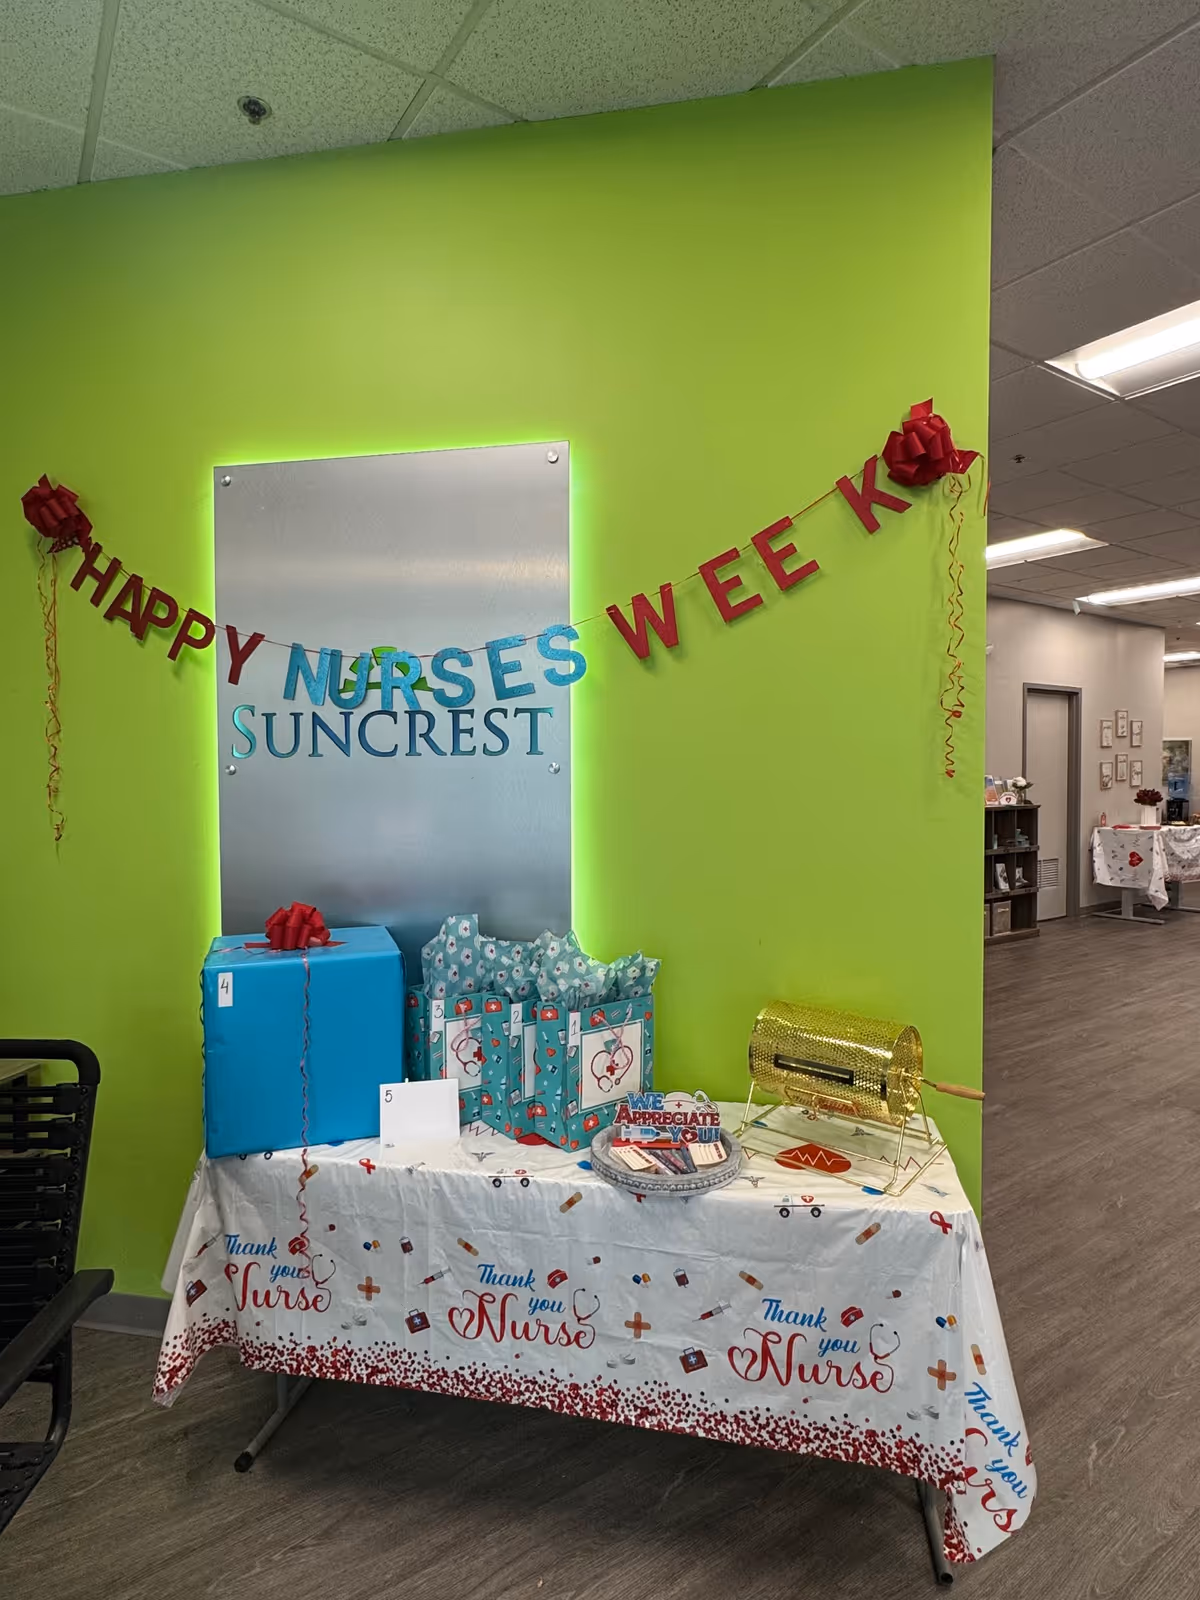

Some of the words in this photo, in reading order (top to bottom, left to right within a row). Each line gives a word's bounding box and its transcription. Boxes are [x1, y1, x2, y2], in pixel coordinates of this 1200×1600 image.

[70, 540, 265, 685] HAPPY
[283, 624, 587, 710] NURSES
[606, 455, 912, 660] WEEK
[231, 704, 554, 759] SUNCREST
[220, 978, 229, 995] 4
[434, 1004, 444, 1019] 3
[512, 1010, 522, 1024] 2
[570, 1019, 578, 1036] 1
[384, 1089, 393, 1103] 5
[627, 1092, 664, 1111] WE
[614, 1104, 720, 1126] APPRECIATE
[224, 1234, 277, 1259] Thank
[477, 1263, 536, 1291] Thank
[528, 1296, 566, 1316] you
[761, 1298, 828, 1332] Thank
[448, 1289, 596, 1350] Nurse
[818, 1337, 861, 1358] you
[728, 1327, 895, 1394] Nurse
[964, 1381, 1021, 1458] Thank
[984, 1458, 1028, 1499] you
